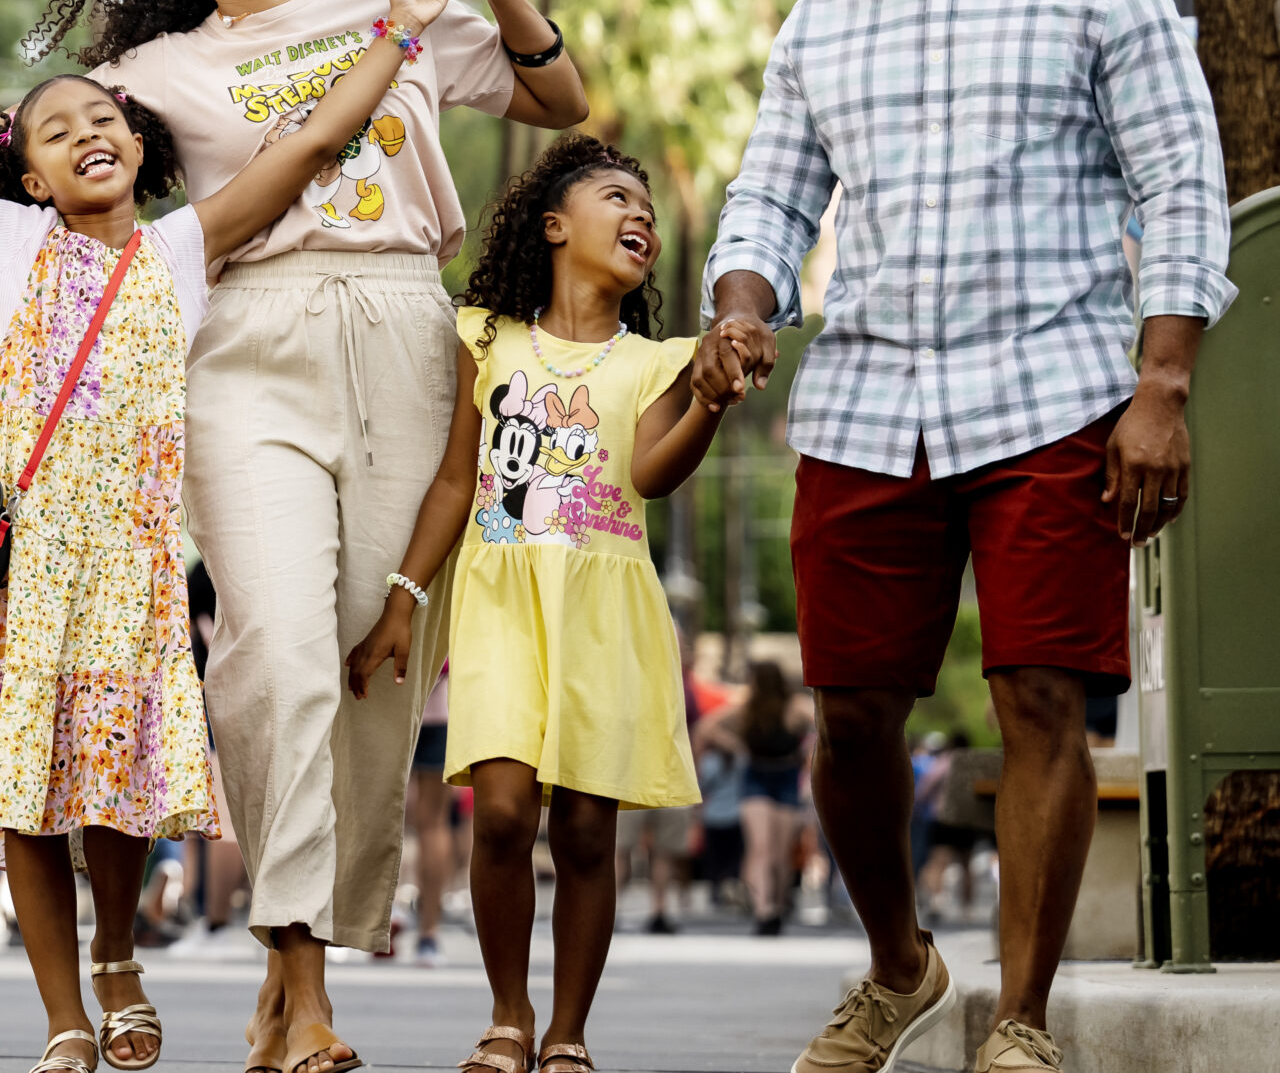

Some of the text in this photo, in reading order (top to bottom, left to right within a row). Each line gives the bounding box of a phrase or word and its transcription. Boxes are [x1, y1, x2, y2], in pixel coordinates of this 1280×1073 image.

[235, 50, 282, 76] WALT
[286, 30, 363, 62] DISNEY'S
[244, 76, 326, 122] STEPS
[572, 465, 622, 511] Love
[616, 501, 632, 518] &
[558, 501, 643, 541] Sunshine
